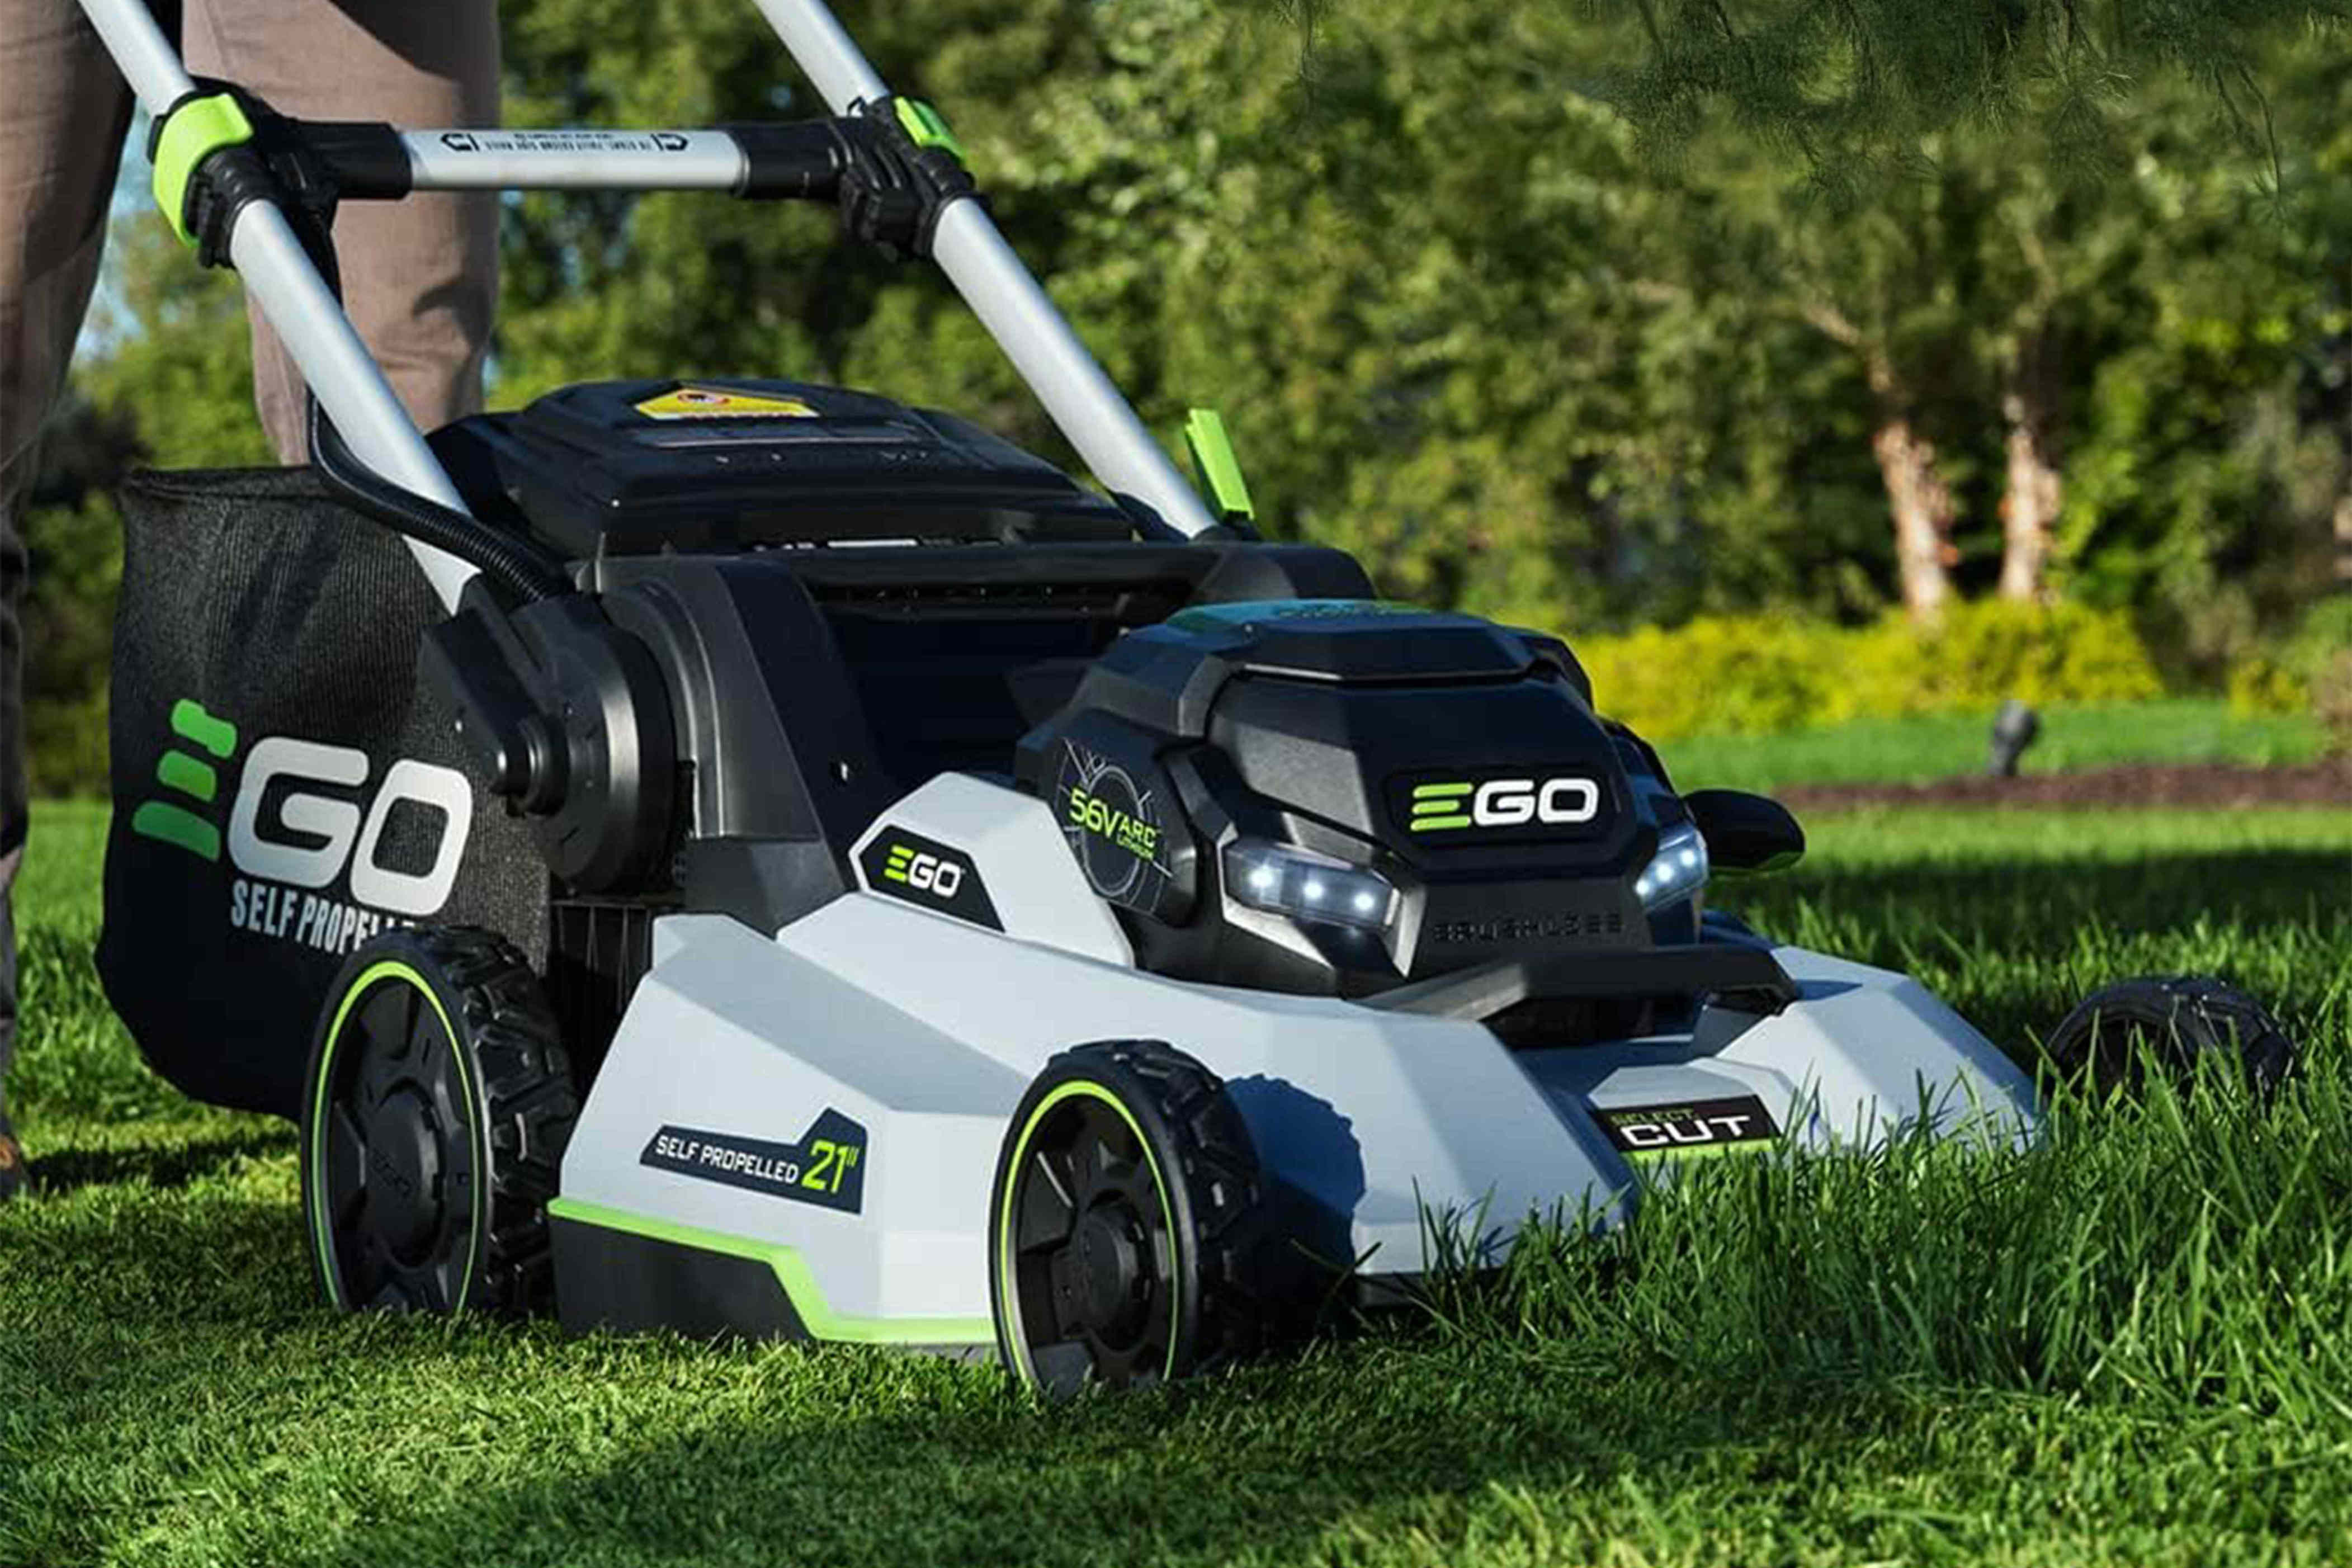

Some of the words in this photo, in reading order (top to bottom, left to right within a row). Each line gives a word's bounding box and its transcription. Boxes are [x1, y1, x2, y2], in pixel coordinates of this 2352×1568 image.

[133, 699, 473, 915] EGO
[1069, 787, 1121, 838] 56V
[1118, 815, 1156, 848] ARC
[1410, 778, 1598, 832] EGO
[884, 844, 961, 898] EGO
[231, 879, 297, 938] SELF
[296, 894, 415, 955] PROPE
[1621, 1115, 1750, 1146] CUT
[655, 1135, 700, 1159] SELF
[700, 1144, 799, 1184] PROPELLED
